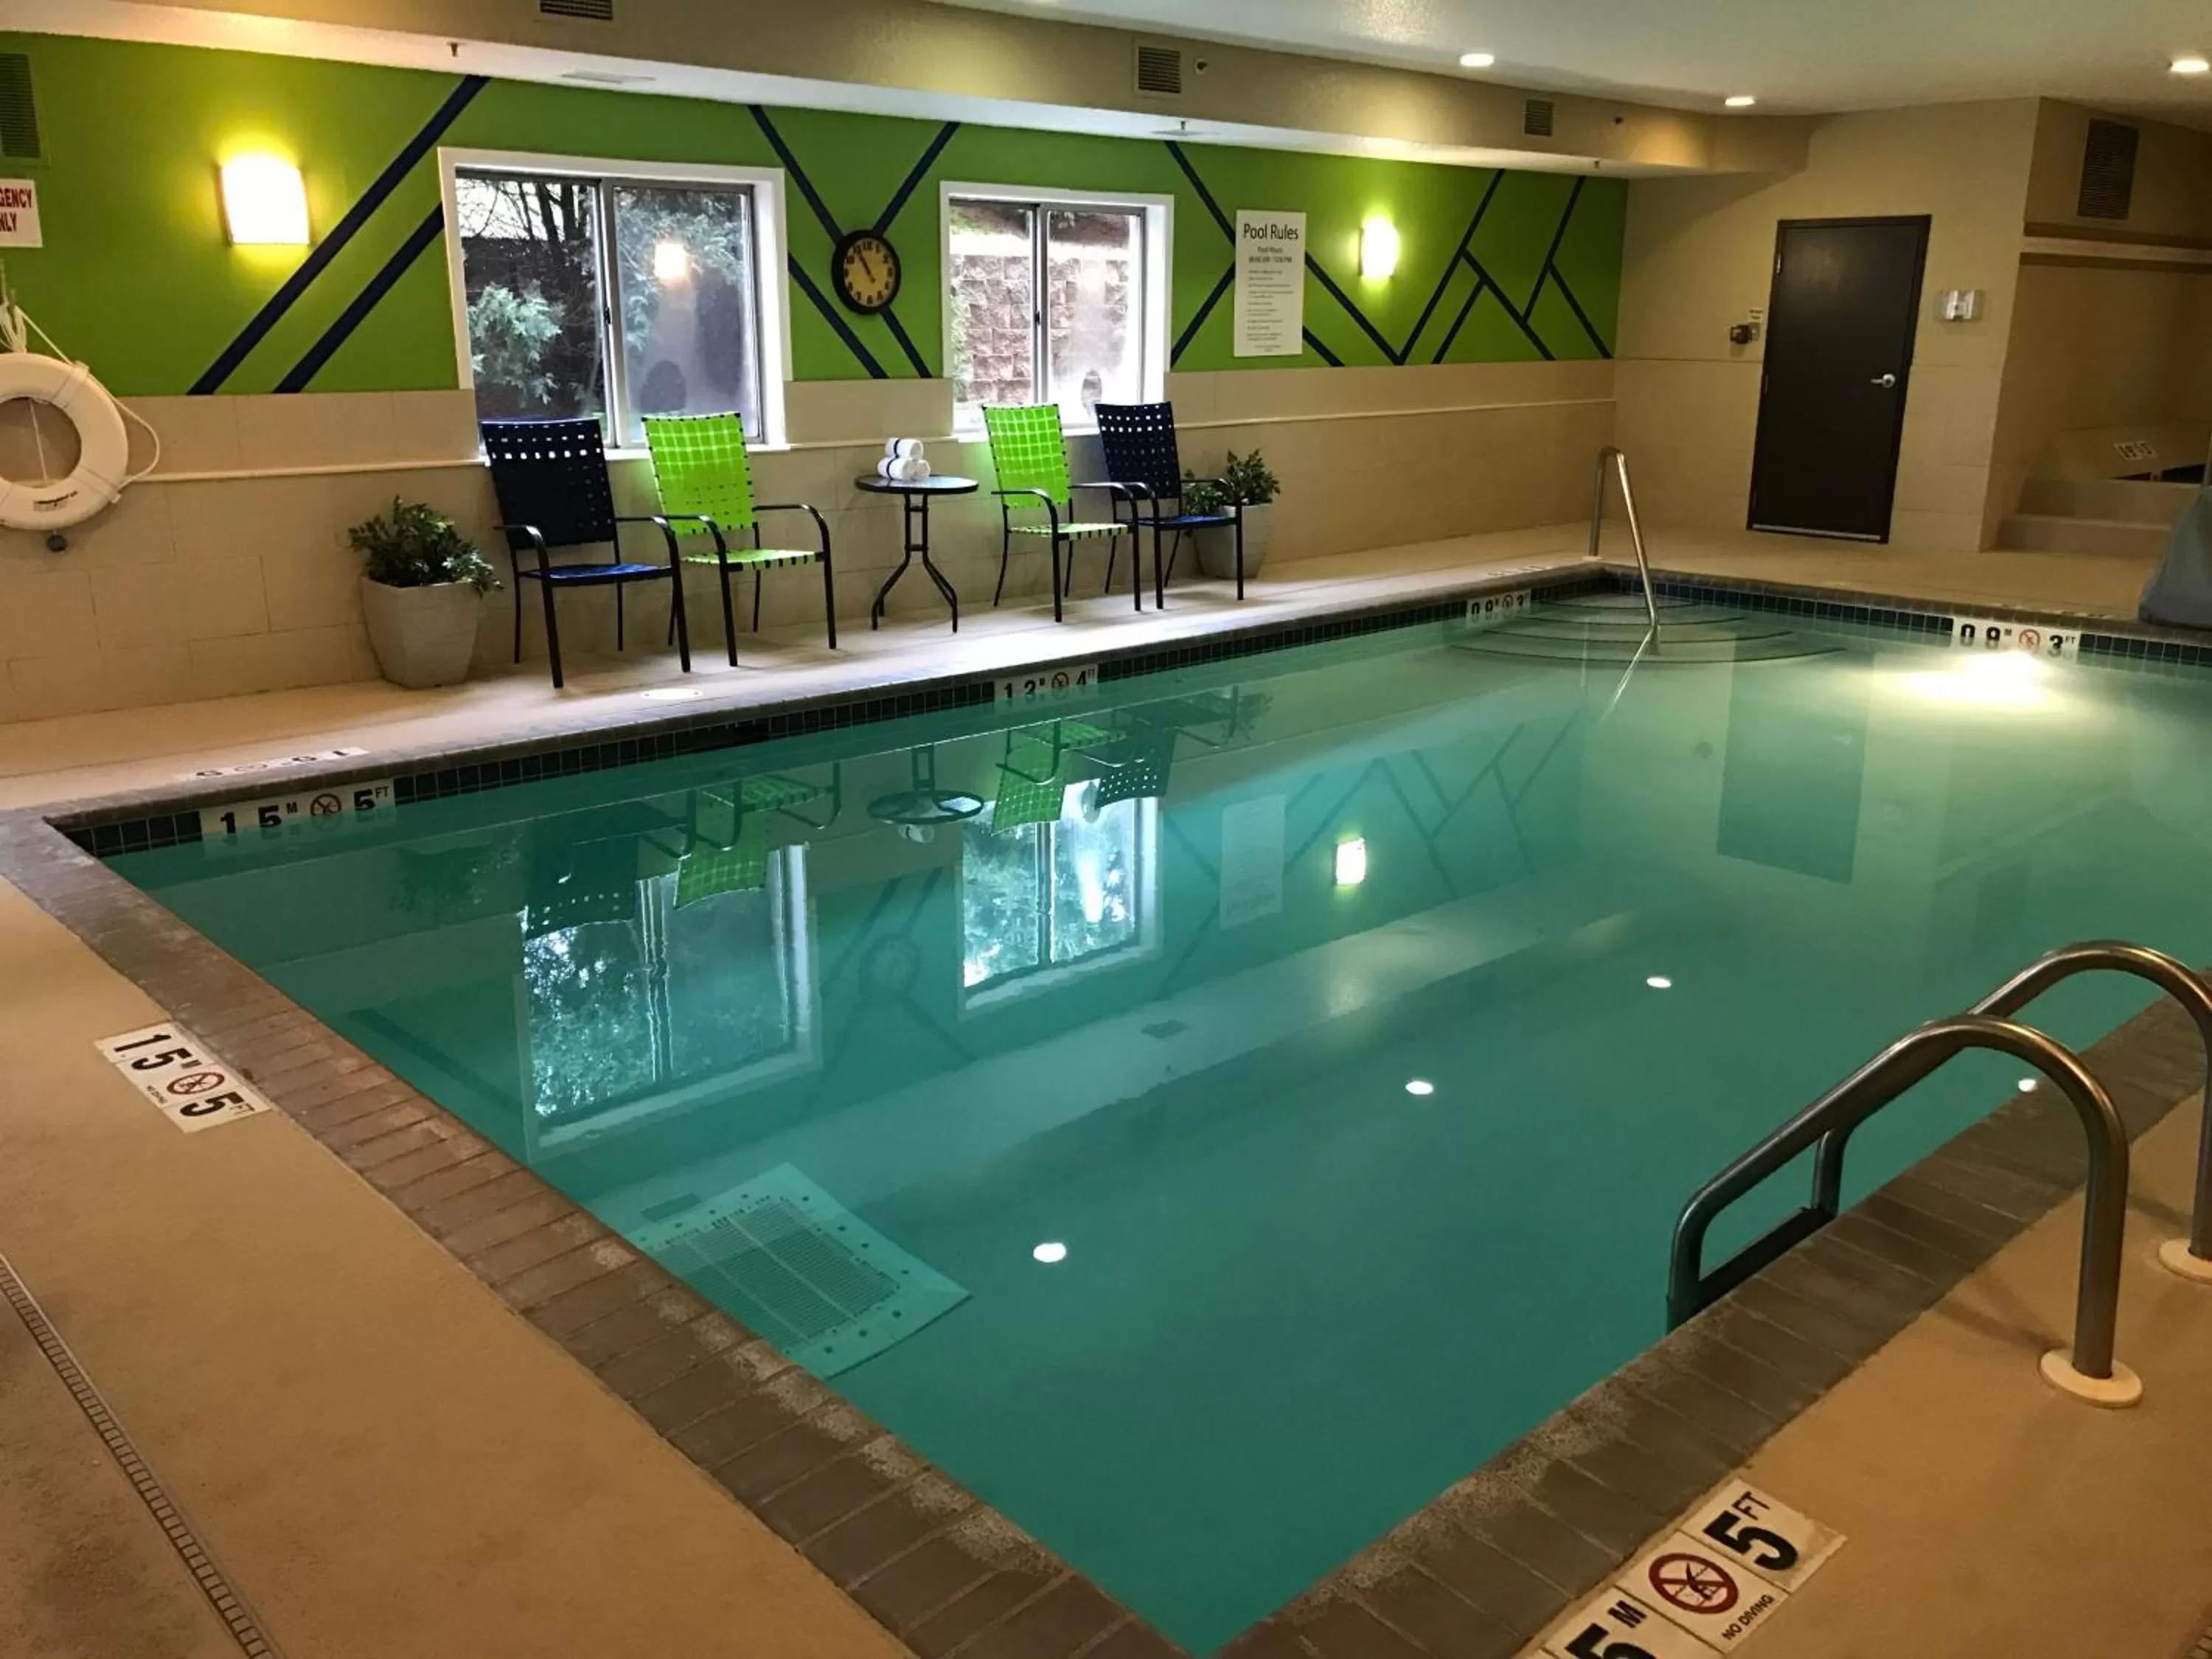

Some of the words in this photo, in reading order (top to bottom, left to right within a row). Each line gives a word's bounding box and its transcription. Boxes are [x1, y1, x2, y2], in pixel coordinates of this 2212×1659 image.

[1243, 223, 1267, 240] Pool
[1270, 223, 1298, 240] Rules
[353, 788, 375, 810] 5
[375, 786, 390, 798] FT
[180, 1091, 245, 1118] 5
[1732, 1491, 1770, 1520] FT
[1703, 1509, 1798, 1571] 5
[1607, 1600, 1648, 1629] M
[1722, 1620, 1742, 1641] NO
[1739, 1594, 1775, 1627] DIVING
